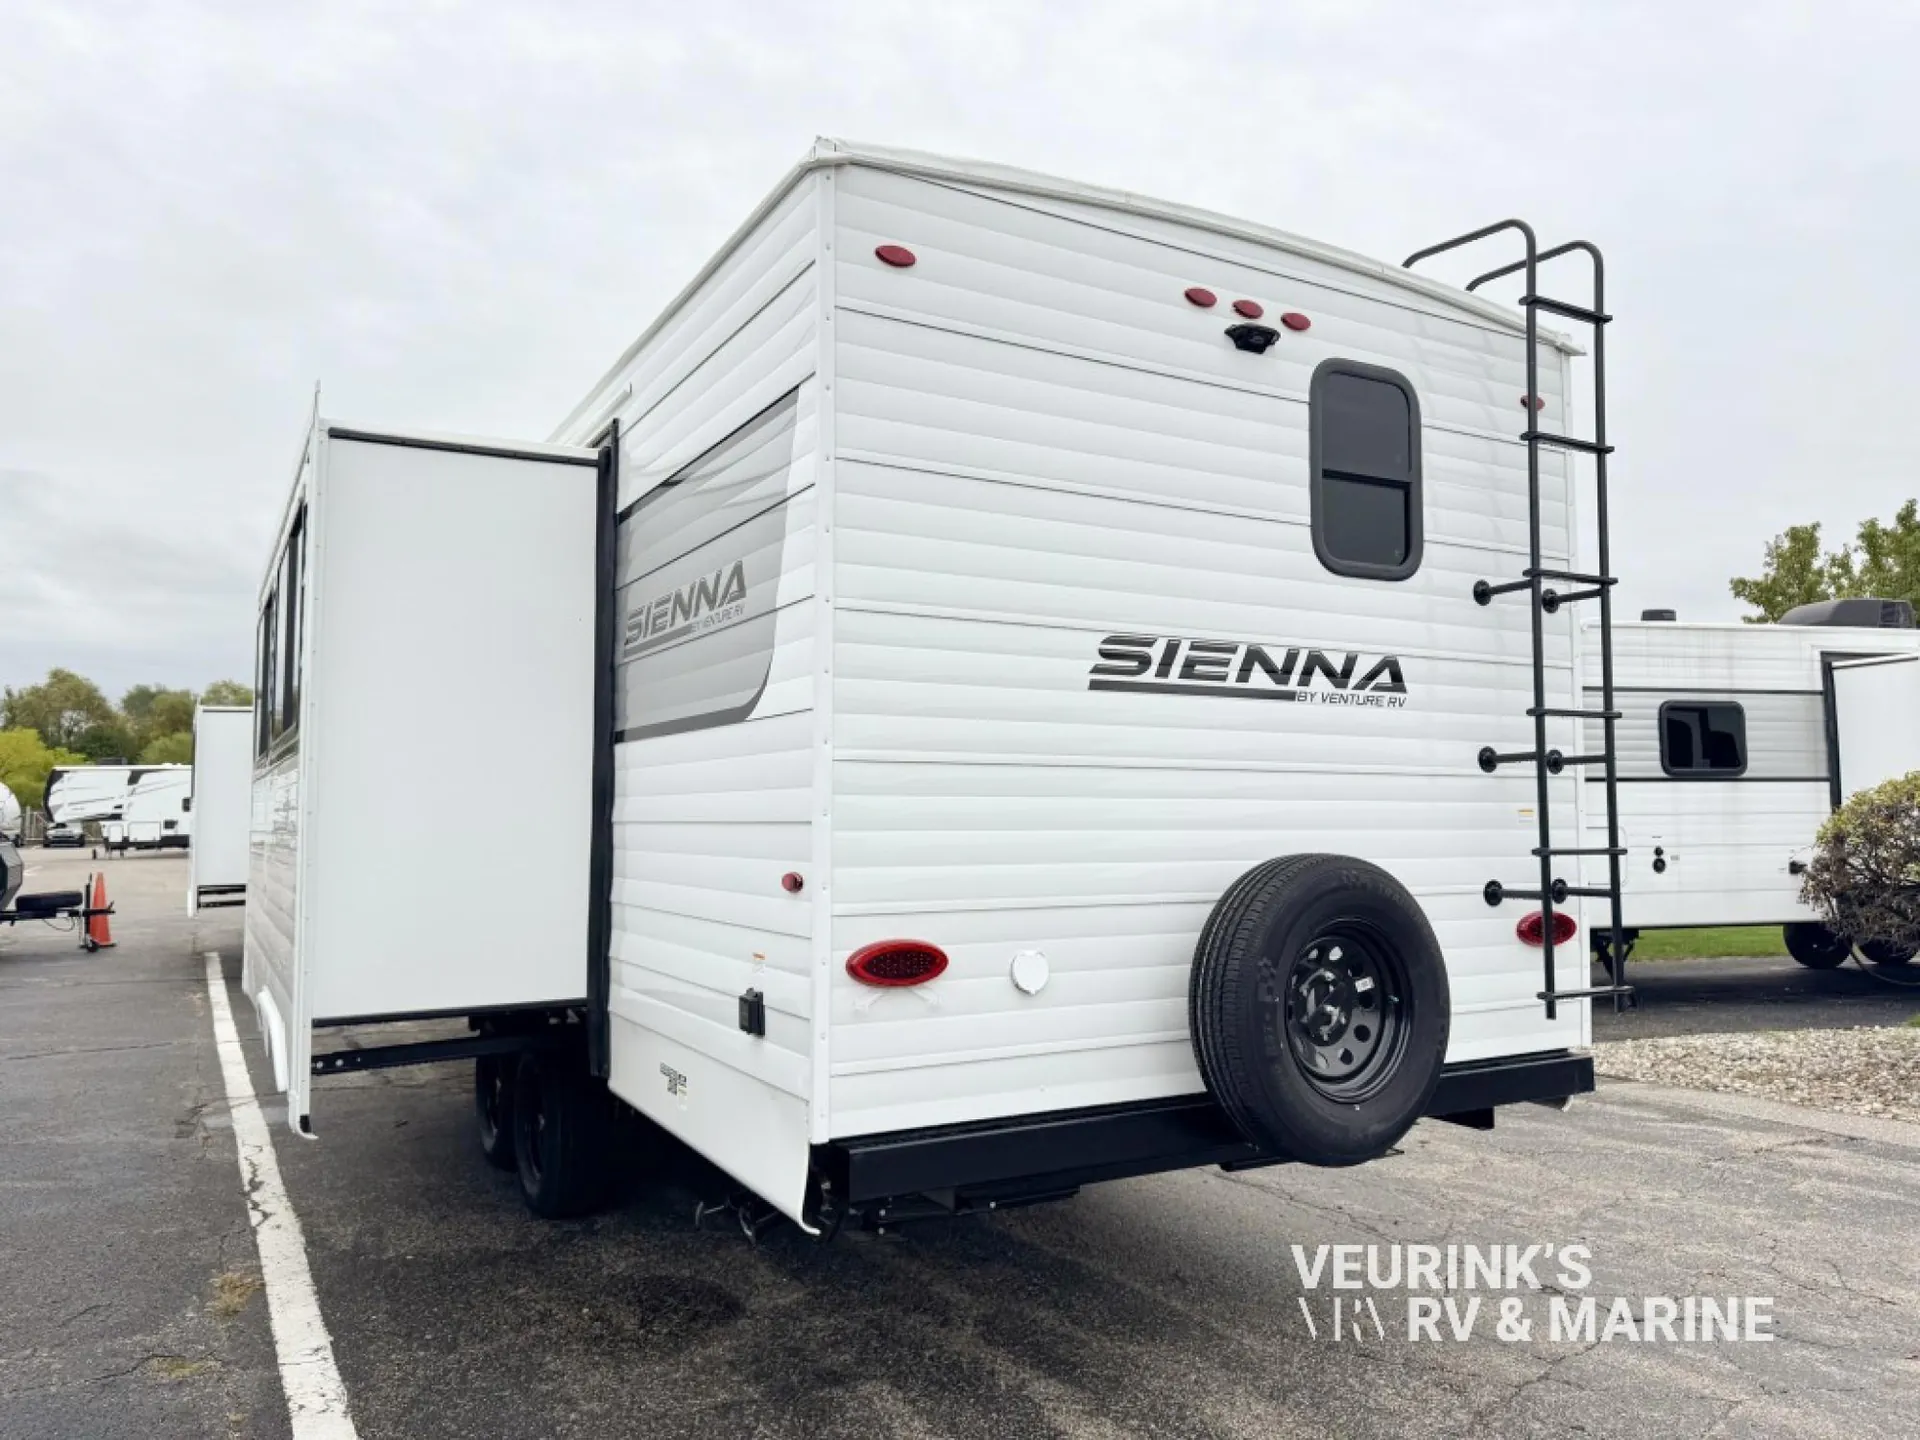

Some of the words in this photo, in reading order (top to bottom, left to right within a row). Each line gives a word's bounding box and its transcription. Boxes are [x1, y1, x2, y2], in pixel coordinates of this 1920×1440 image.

[624, 560, 747, 646] SIENNA
[1089, 635, 1407, 693] SIENNA
[1296, 691, 1317, 703] BY
[1321, 692, 1385, 707] VENTURE
[1387, 696, 1407, 708] RV
